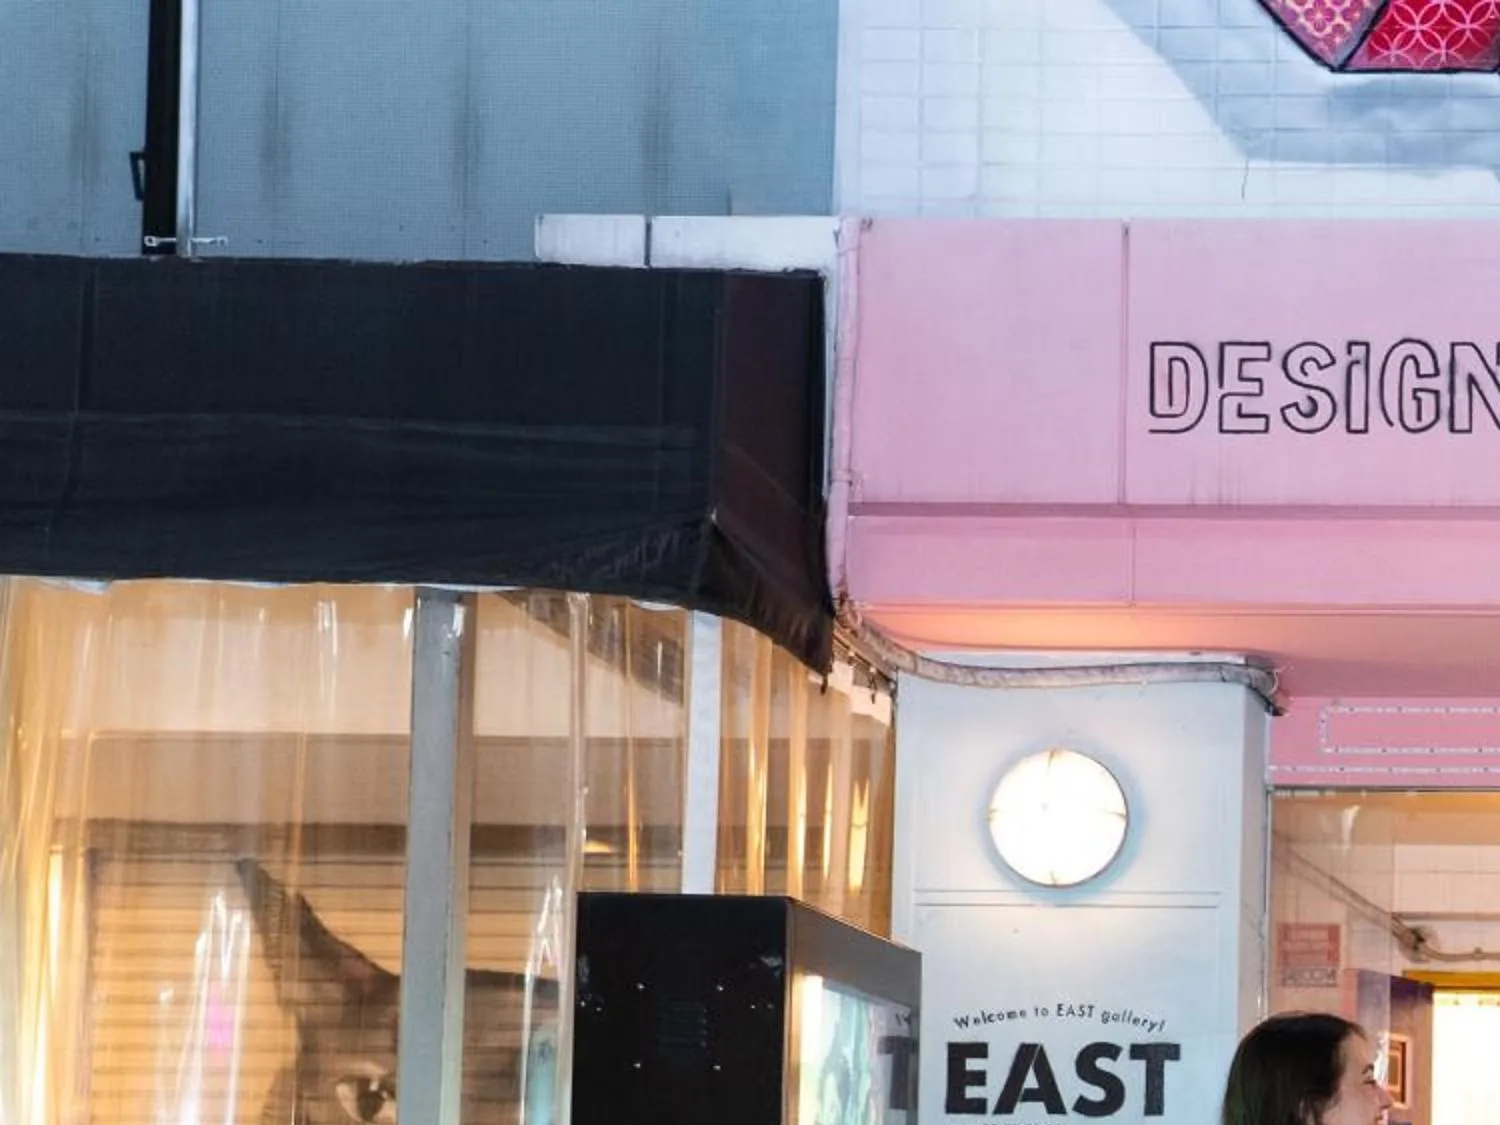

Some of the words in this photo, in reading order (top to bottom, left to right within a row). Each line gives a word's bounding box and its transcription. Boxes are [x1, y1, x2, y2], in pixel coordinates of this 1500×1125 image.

[953, 1008, 1027, 1029] Welcome
[1033, 1006, 1049, 1017] to
[1056, 1003, 1095, 1018] EAST
[945, 1041, 1181, 1117] EAST
